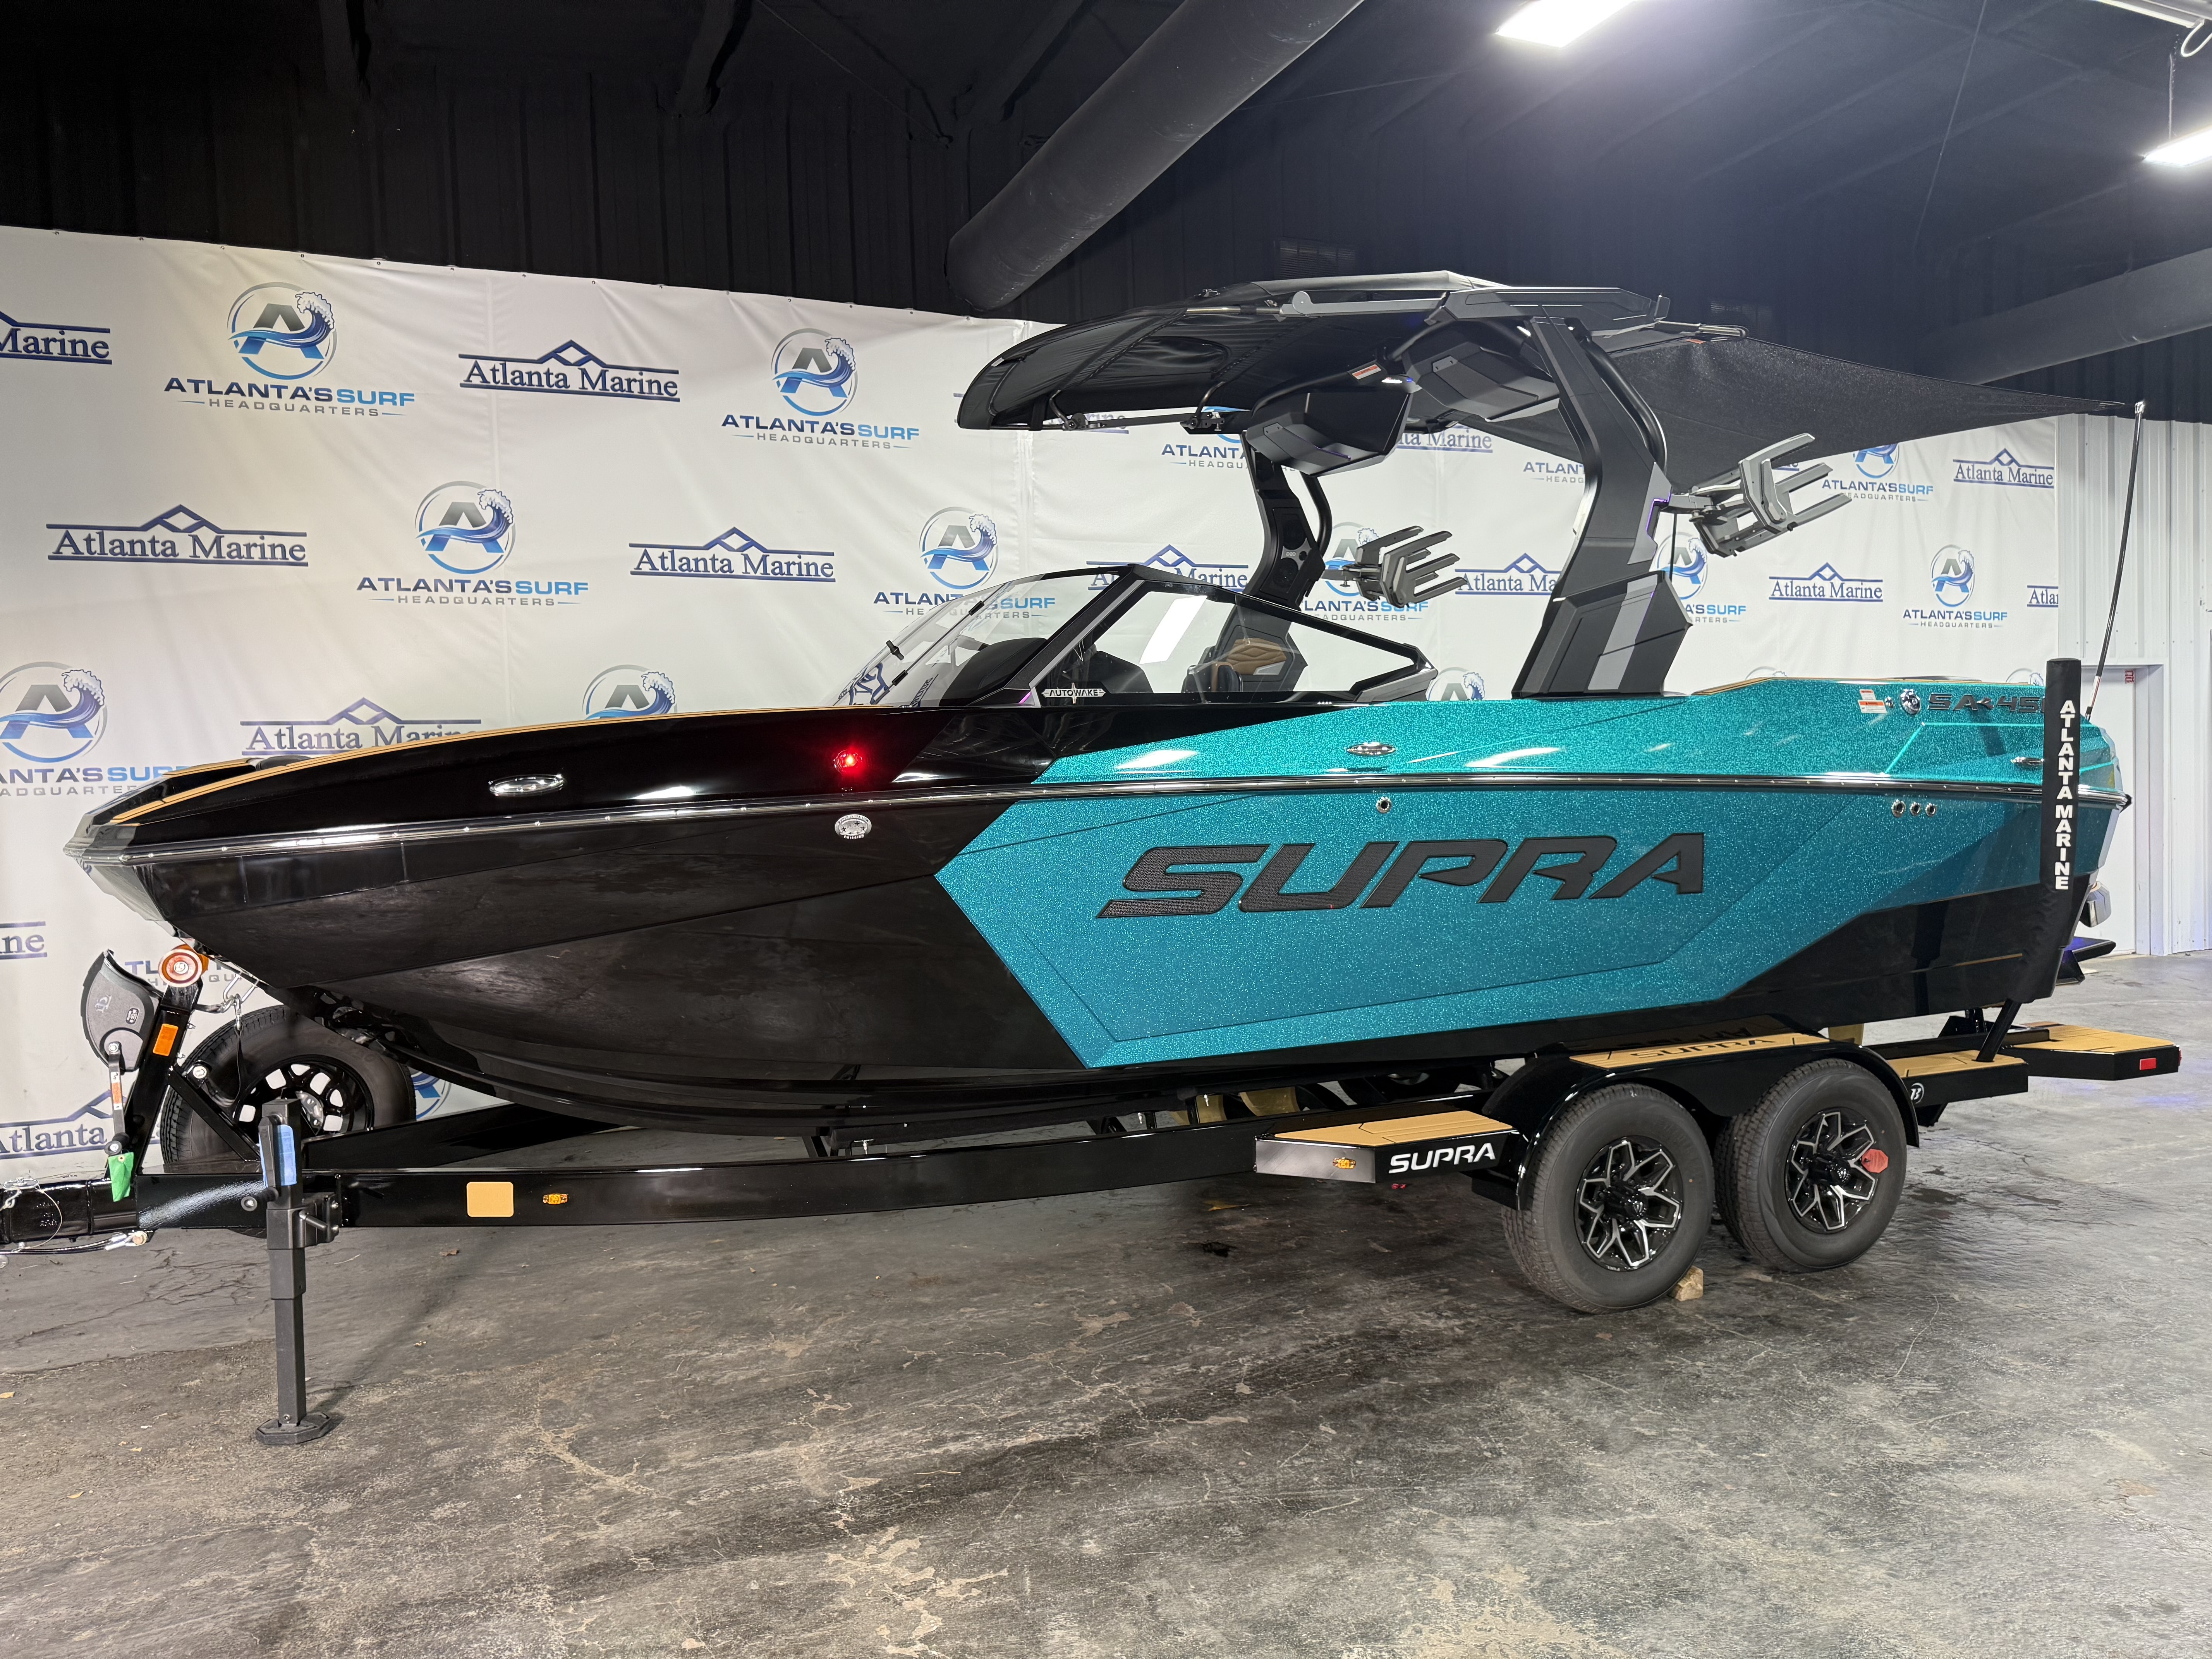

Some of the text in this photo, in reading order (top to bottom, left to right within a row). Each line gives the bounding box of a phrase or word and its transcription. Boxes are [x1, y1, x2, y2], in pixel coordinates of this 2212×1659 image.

[463, 361, 678, 397] Atlanta Marine
[164, 377, 415, 407] ATLANTA'S SURF
[210, 398, 378, 416] HEADQUARTERS
[721, 414, 919, 440] ATLANTA'S SURF
[757, 433, 891, 449] HEADQUARTERS
[1427, 428, 1492, 449] Marine
[1955, 463, 2053, 485] Atlanta Marine
[1822, 479, 1934, 495] ATLANTA'S SURF
[1844, 493, 1916, 502] EADQUARTERS
[52, 530, 306, 561] Atlanta Marine
[634, 548, 834, 578] Atlanta Marine
[357, 577, 589, 596] ATLANTA'S SURF
[1771, 580, 1882, 599] Atlanta Marine
[398, 595, 555, 606] HEADQUARTERS
[1707, 605, 1746, 615] SURF
[1903, 609, 2008, 620] ATLANTA'S SURF
[246, 725, 362, 750] Atlanta
[2055, 700, 2076, 890] ATLANTA MARINE
[1096, 832, 1705, 919] SUPRA
[1631, 1039, 1776, 1058] SUPRA
[1388, 1142, 1496, 1174] SUPRA
